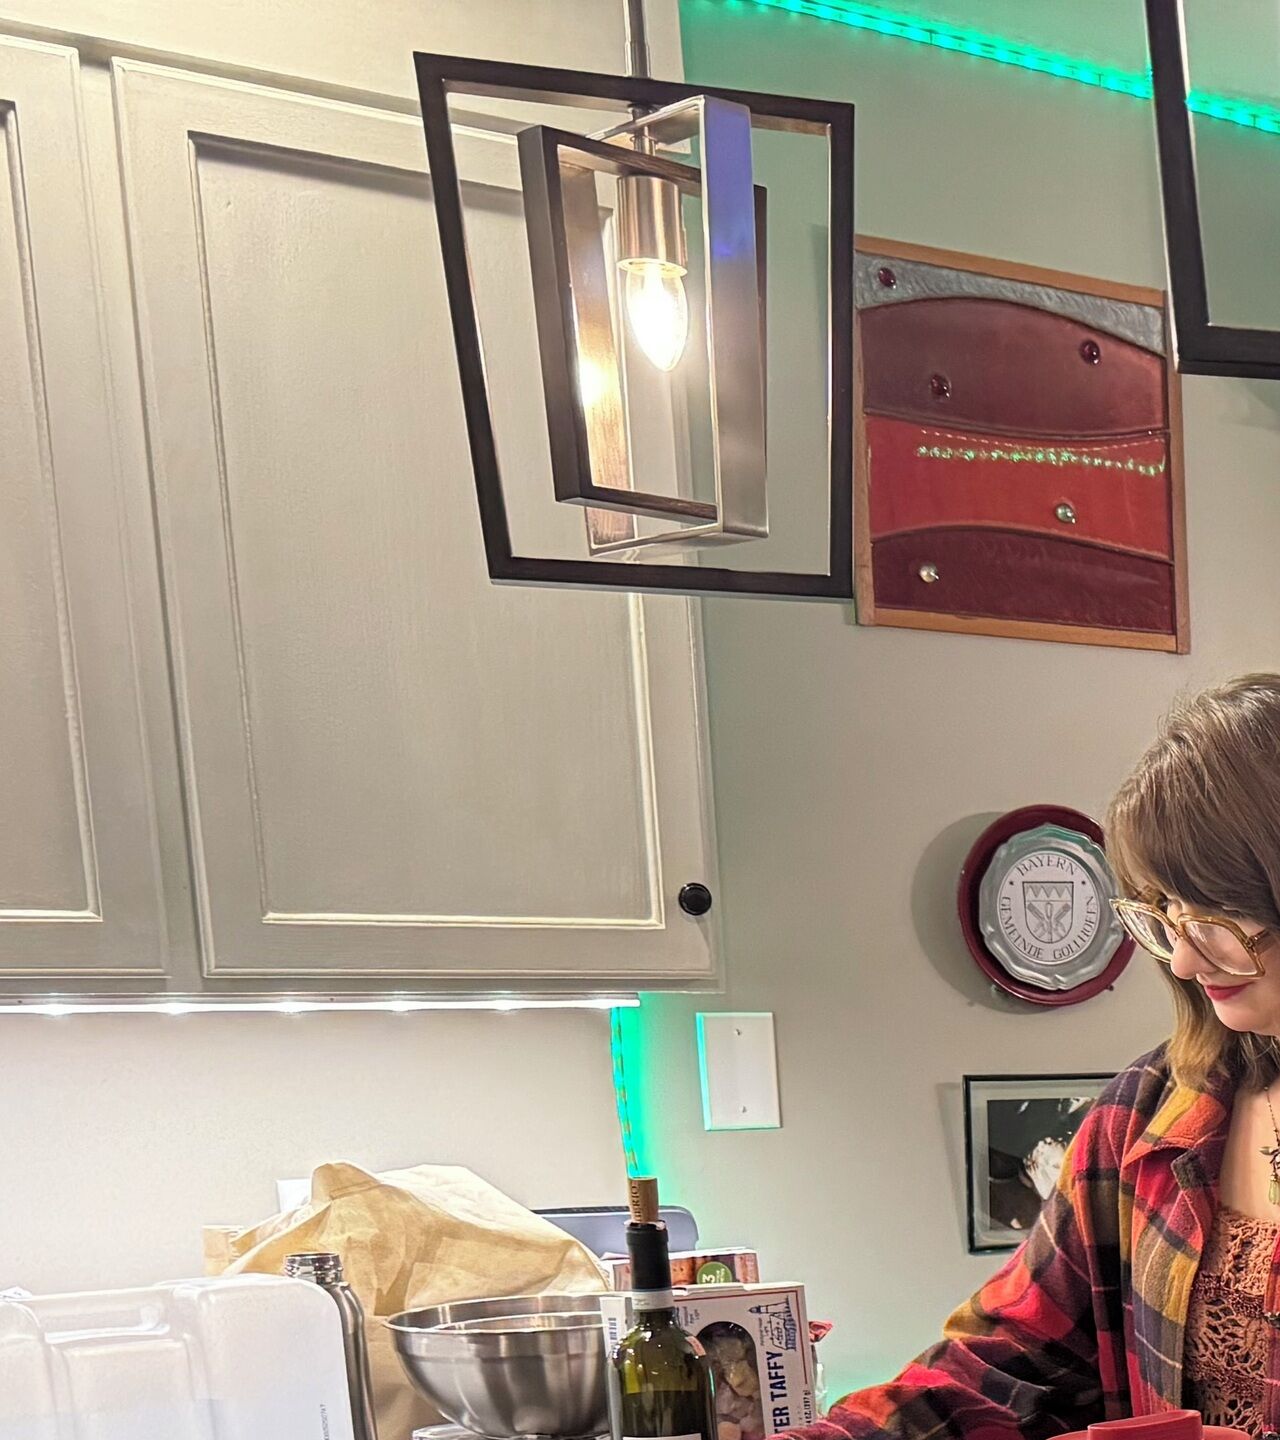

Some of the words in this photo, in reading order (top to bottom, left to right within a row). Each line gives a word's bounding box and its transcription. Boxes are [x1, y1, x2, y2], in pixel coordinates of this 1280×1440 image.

[1015, 855, 1078, 876] BAYERN
[1000, 896, 1045, 959] GEMEINDE
[766, 1351, 788, 1402] TAFFY
